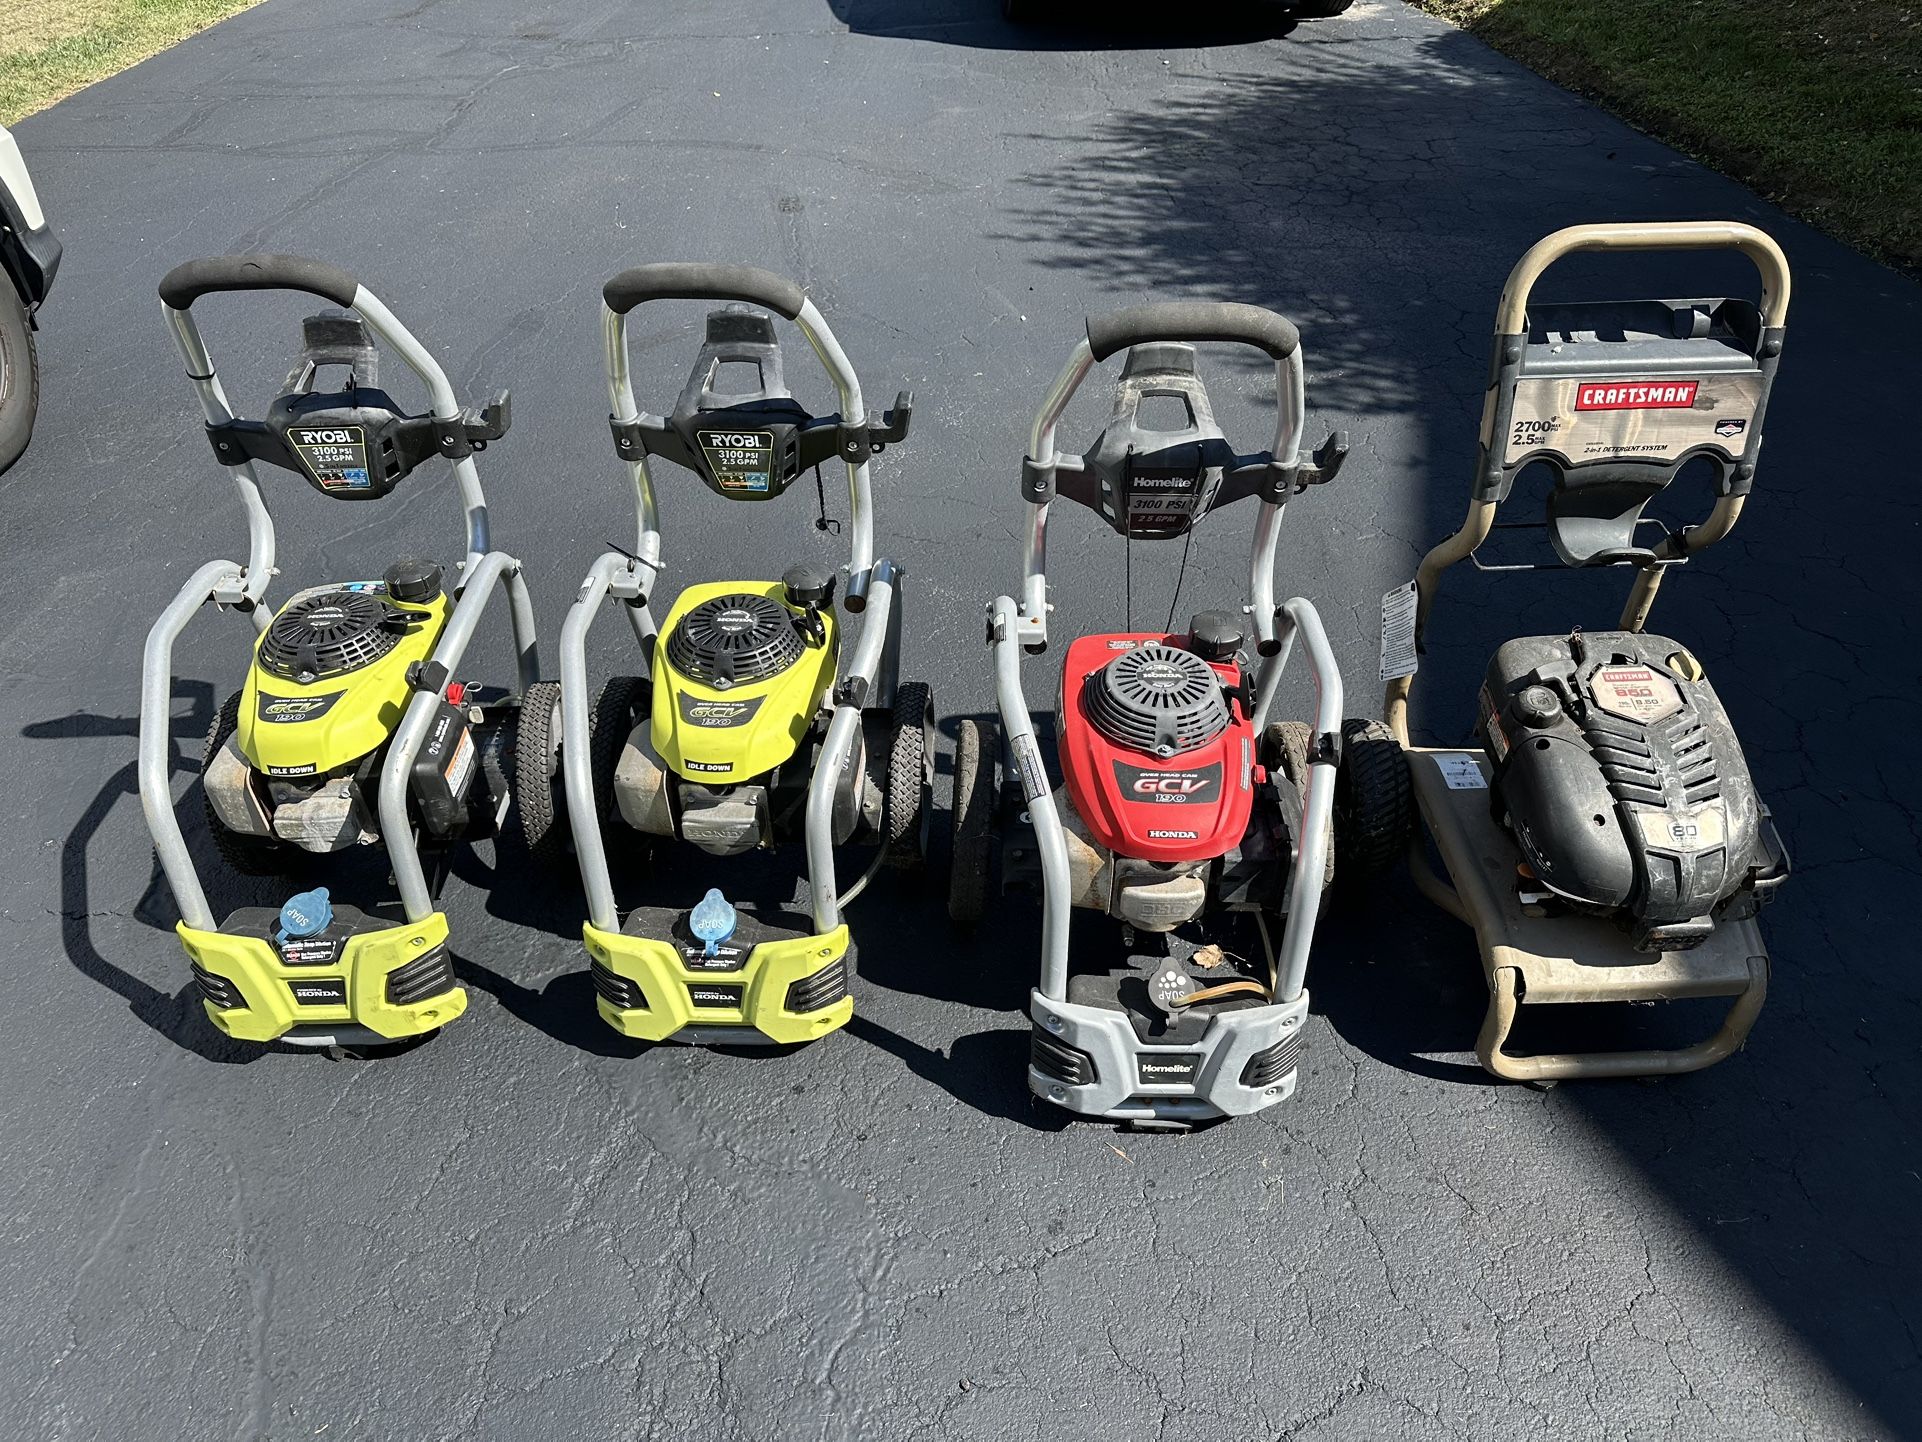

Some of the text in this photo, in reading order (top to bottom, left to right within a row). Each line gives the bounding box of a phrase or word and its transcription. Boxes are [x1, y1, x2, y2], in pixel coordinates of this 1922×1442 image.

[1583, 387, 1690, 404] CRAFTSMAN
[1514, 421, 1551, 432] 2700
[300, 430, 351, 444] RYOBI
[710, 434, 759, 448] RYOBI
[1512, 434, 1535, 445] 2.5
[312, 447, 337, 455] 3100
[1134, 477, 1192, 488] Homelite
[1134, 500, 1187, 509] 3100 PSI
[1615, 688, 1653, 697] 850
[266, 702, 325, 714] GCV
[690, 707, 748, 718] GCV
[290, 766, 314, 774] DOWN
[1133, 778, 1210, 793] GCV
[1155, 794, 1186, 802] 190
[1149, 830, 1196, 838] HONDA
[1672, 825, 1697, 836] 80
[286, 908, 309, 927] SOAP
[698, 919, 724, 929] SOAP
[1159, 990, 1185, 1000] SOAP
[1142, 1064, 1191, 1072] Homelite
